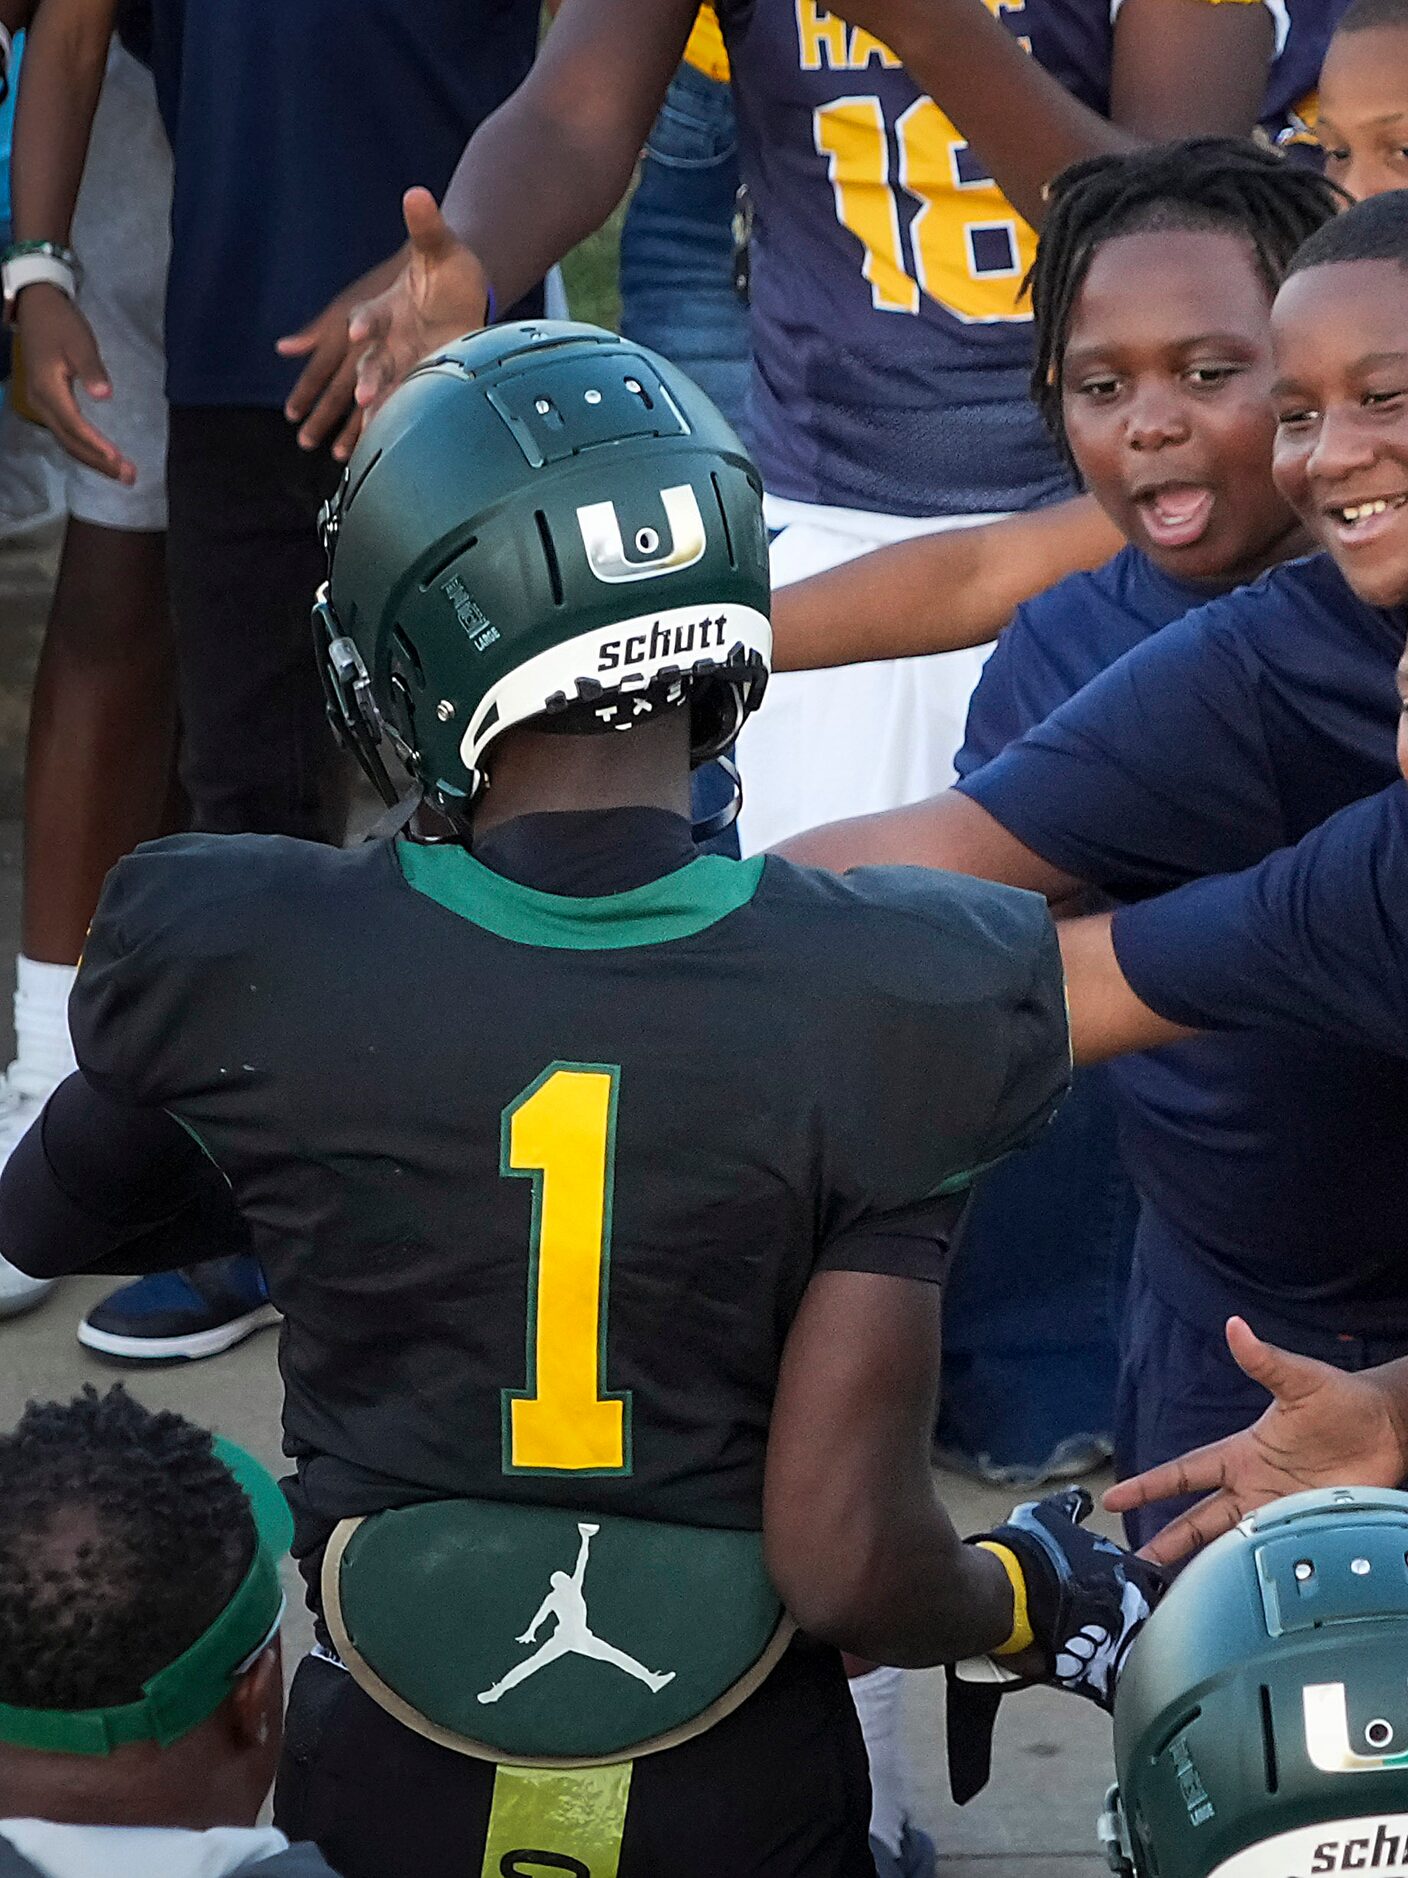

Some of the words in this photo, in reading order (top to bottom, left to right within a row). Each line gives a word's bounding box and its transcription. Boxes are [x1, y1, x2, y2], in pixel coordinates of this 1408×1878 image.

[813, 95, 1041, 324] 18
[576, 484, 706, 584] U
[598, 614, 727, 672] schutt
[499, 1060, 633, 1477] 1
